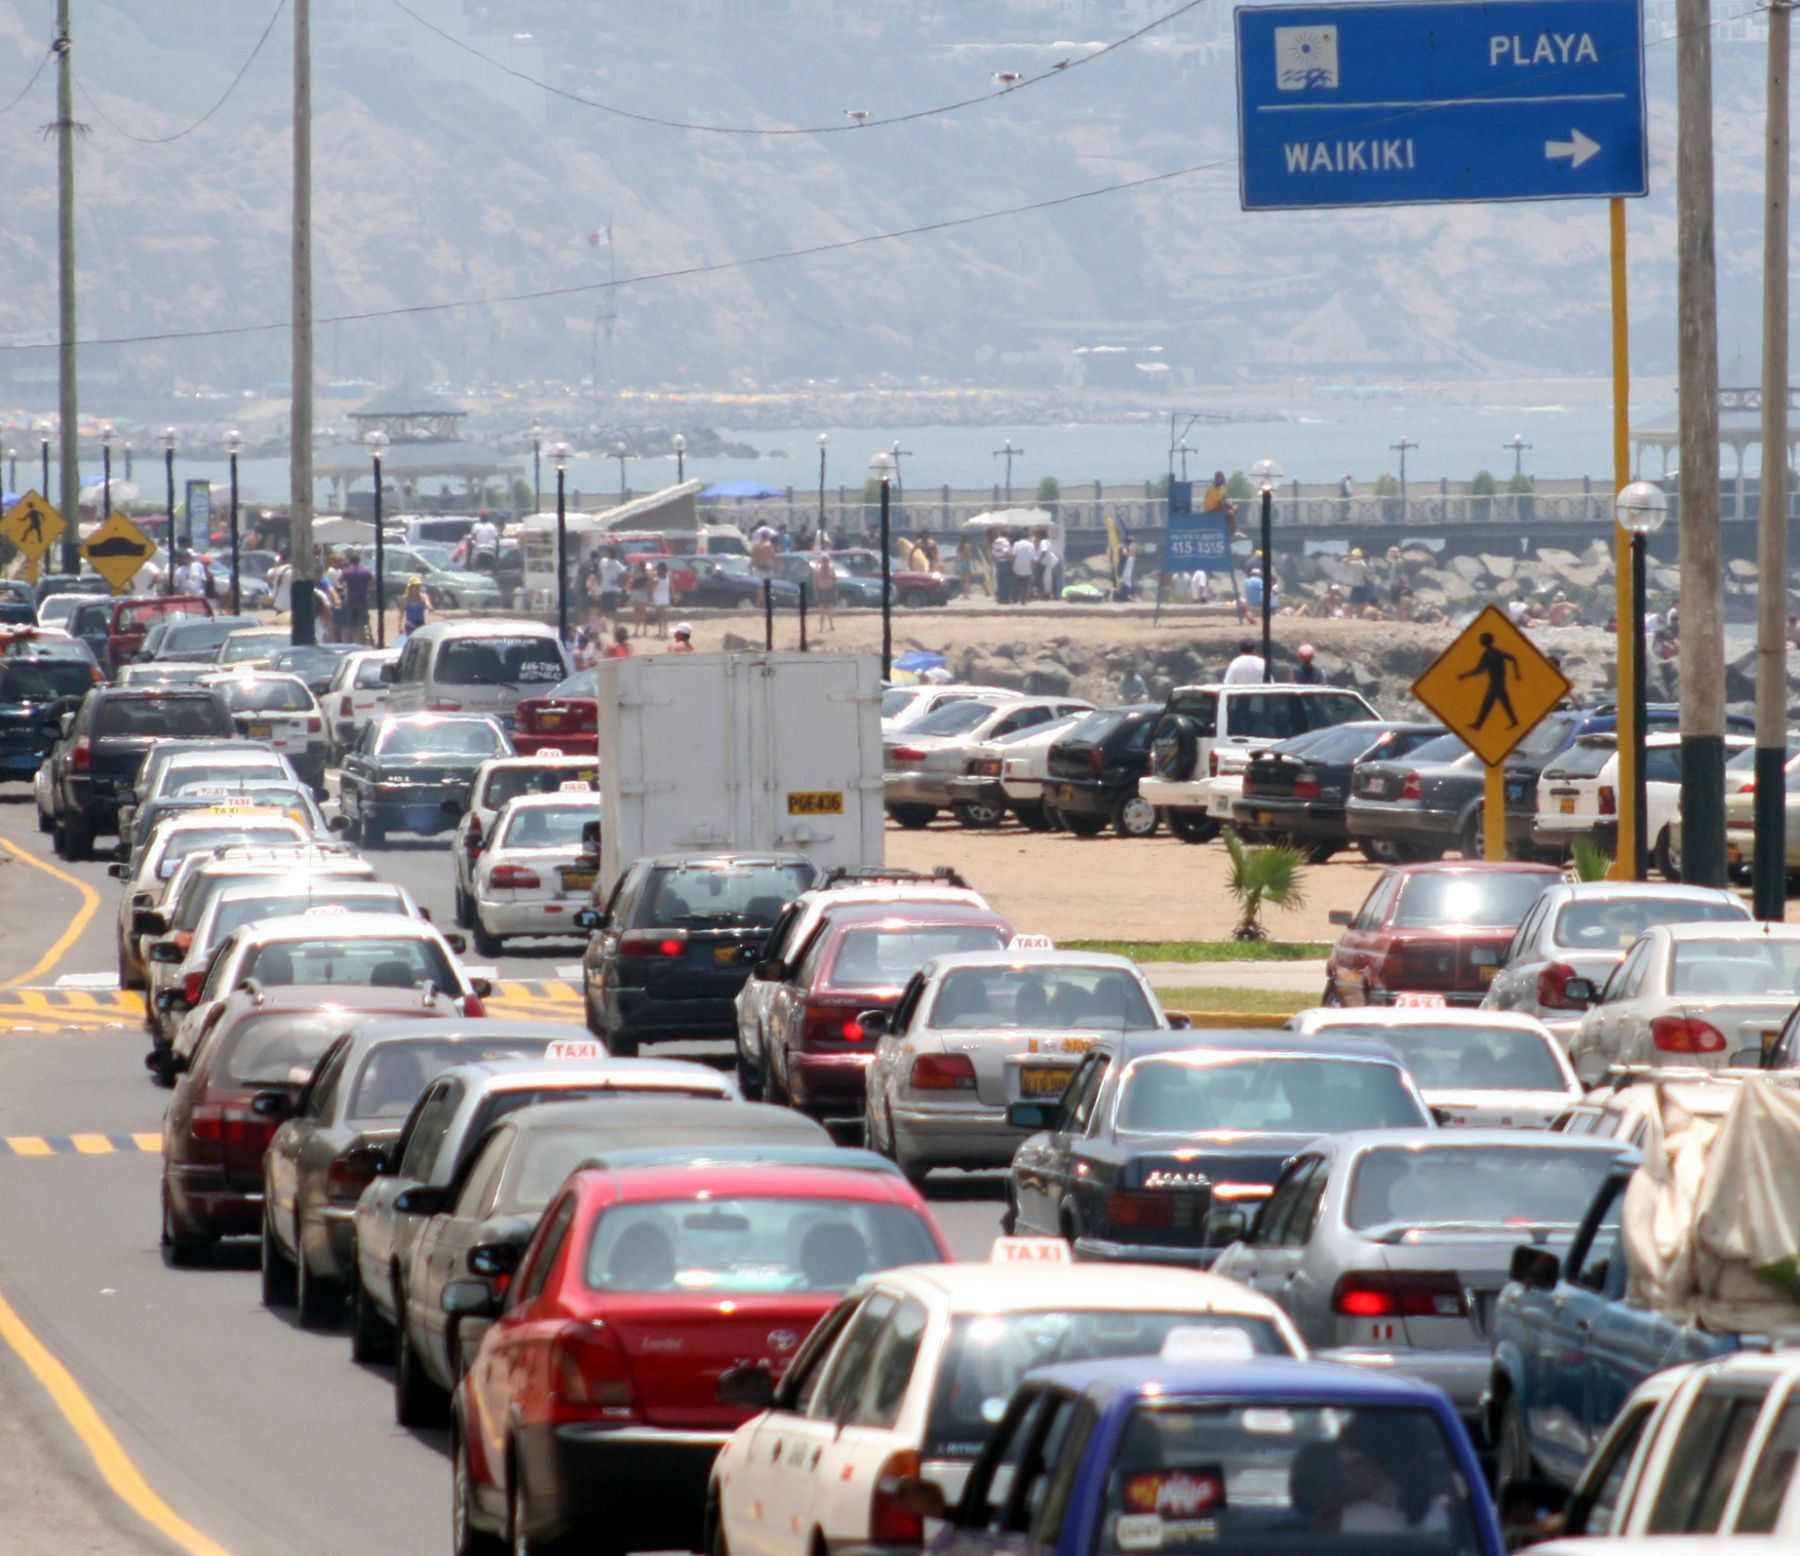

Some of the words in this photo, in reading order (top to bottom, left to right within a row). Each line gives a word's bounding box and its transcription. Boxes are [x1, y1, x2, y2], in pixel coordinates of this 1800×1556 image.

[1489, 32, 1599, 67] PLAYA
[1284, 138, 1416, 174] WAIKIKI
[228, 798, 250, 806] TAXI
[213, 806, 239, 814] TAXI
[1015, 937, 1050, 949] TAXI
[551, 1043, 597, 1057] TAXI
[1001, 1244, 1062, 1262] TAXI
